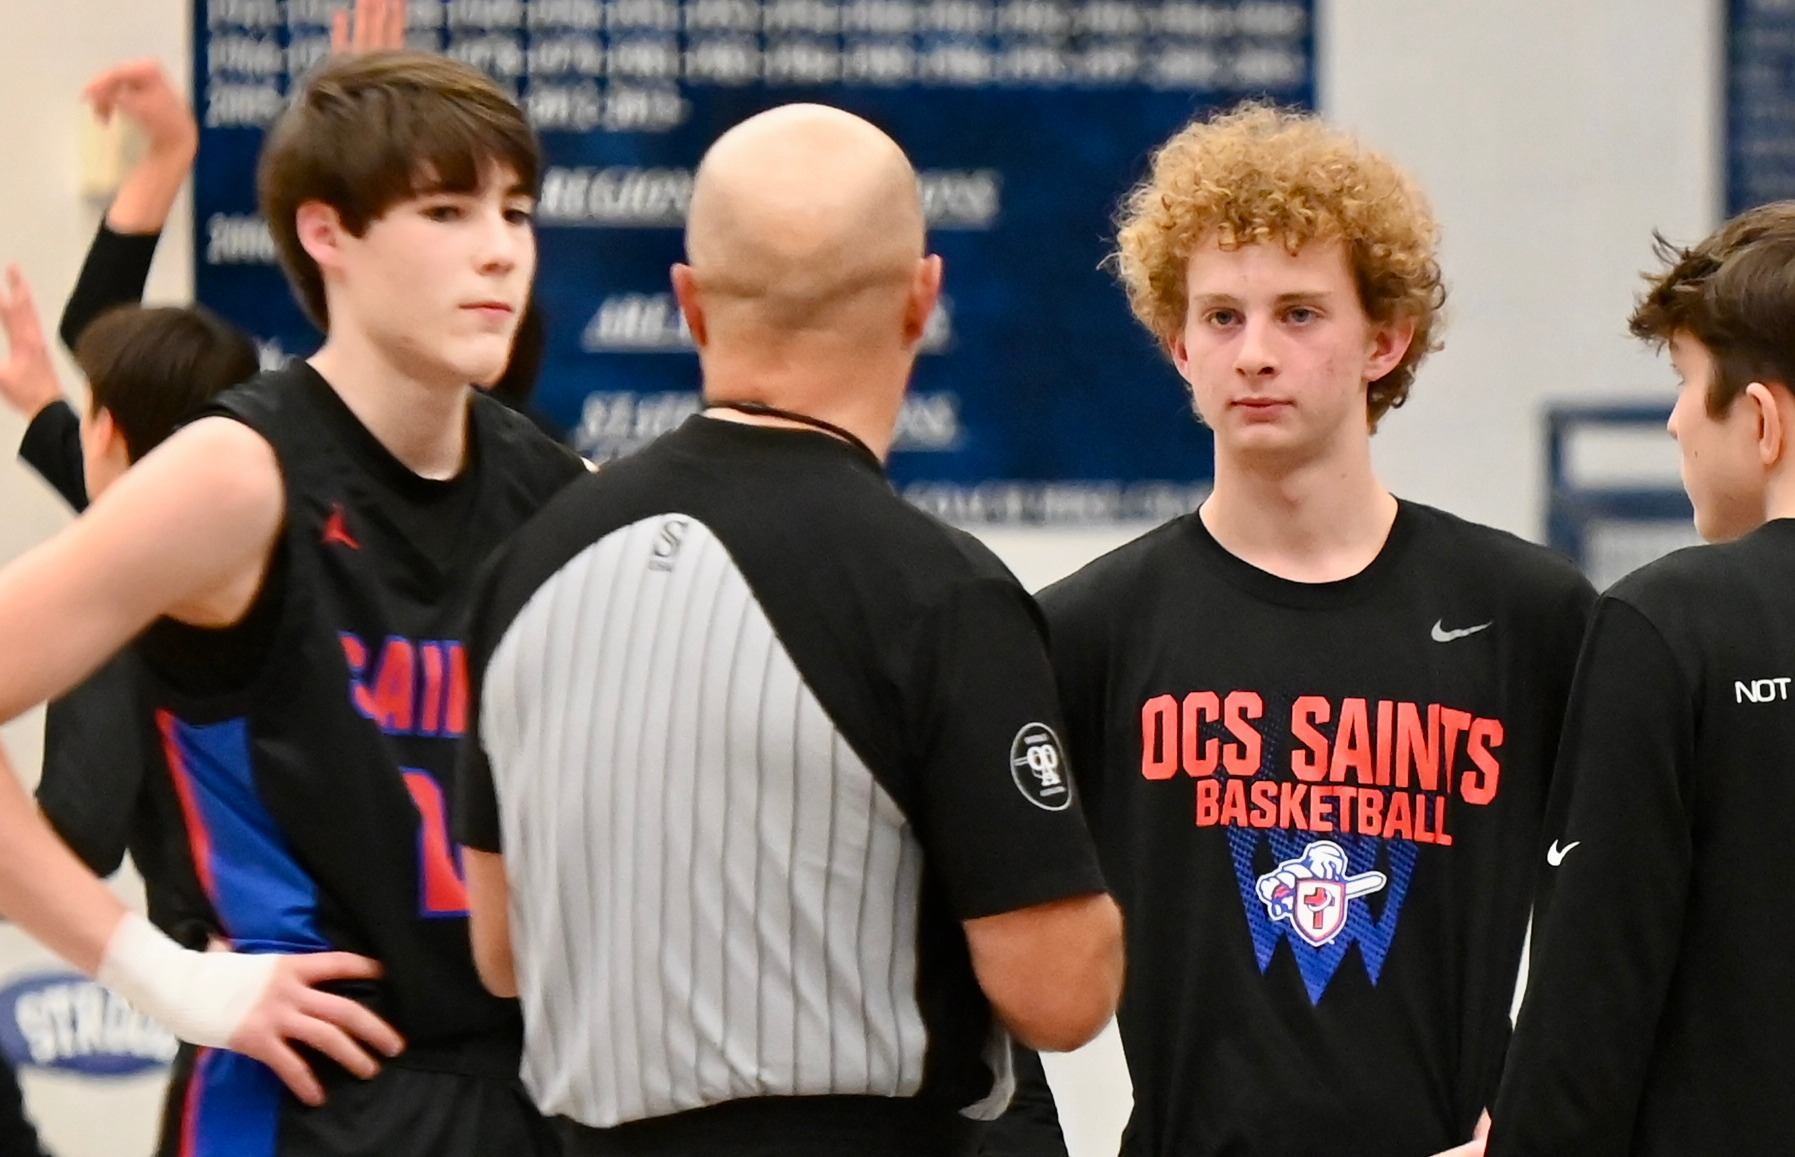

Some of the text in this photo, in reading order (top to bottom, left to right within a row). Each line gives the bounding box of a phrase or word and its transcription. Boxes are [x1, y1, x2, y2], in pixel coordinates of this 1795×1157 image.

[1734, 677, 1792, 704] NOT
[1141, 690, 1504, 806] OCS SAINTS
[1195, 778, 1453, 846] BASKETBALL
